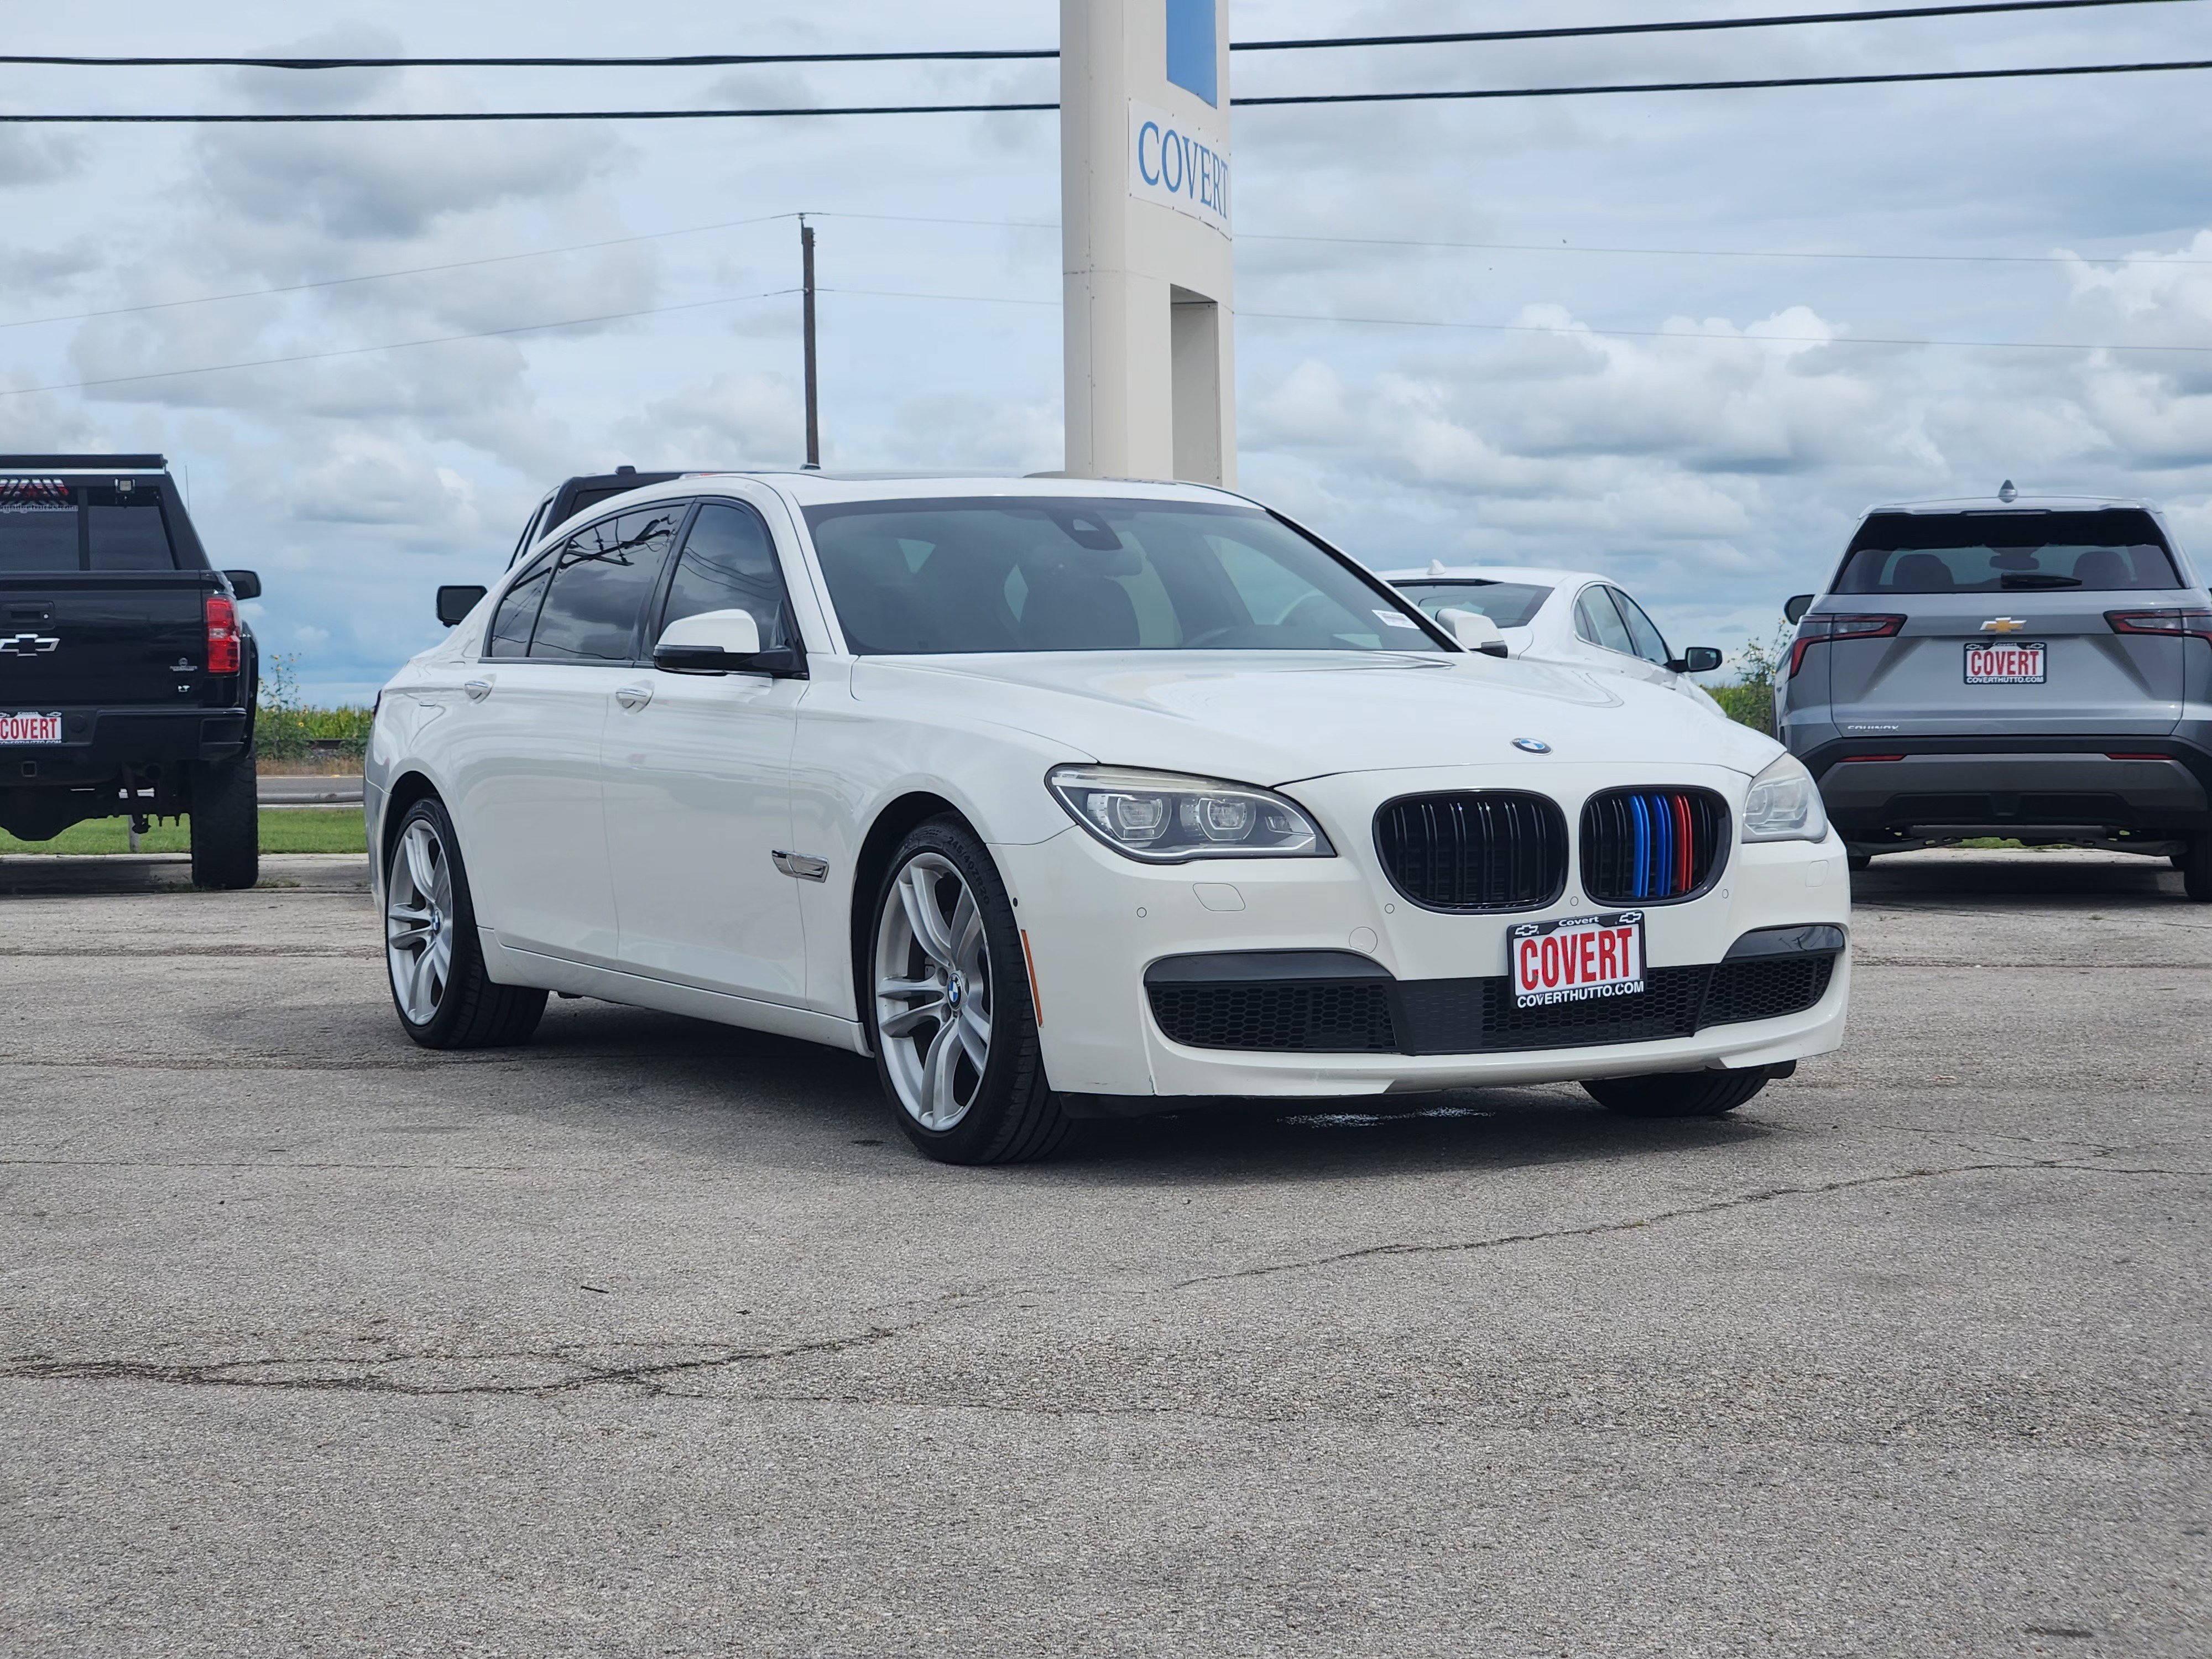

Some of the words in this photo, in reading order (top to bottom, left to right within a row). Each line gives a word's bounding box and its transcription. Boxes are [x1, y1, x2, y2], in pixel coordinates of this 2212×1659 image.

[1138, 121, 1229, 220] COVERT
[1971, 651, 2039, 676] COVERT
[0, 718, 58, 740] COVERT
[1558, 916, 1600, 927] Covert
[1520, 927, 1632, 991] COVERT
[1517, 980, 1644, 1009] COVERTHUTTO.COM
